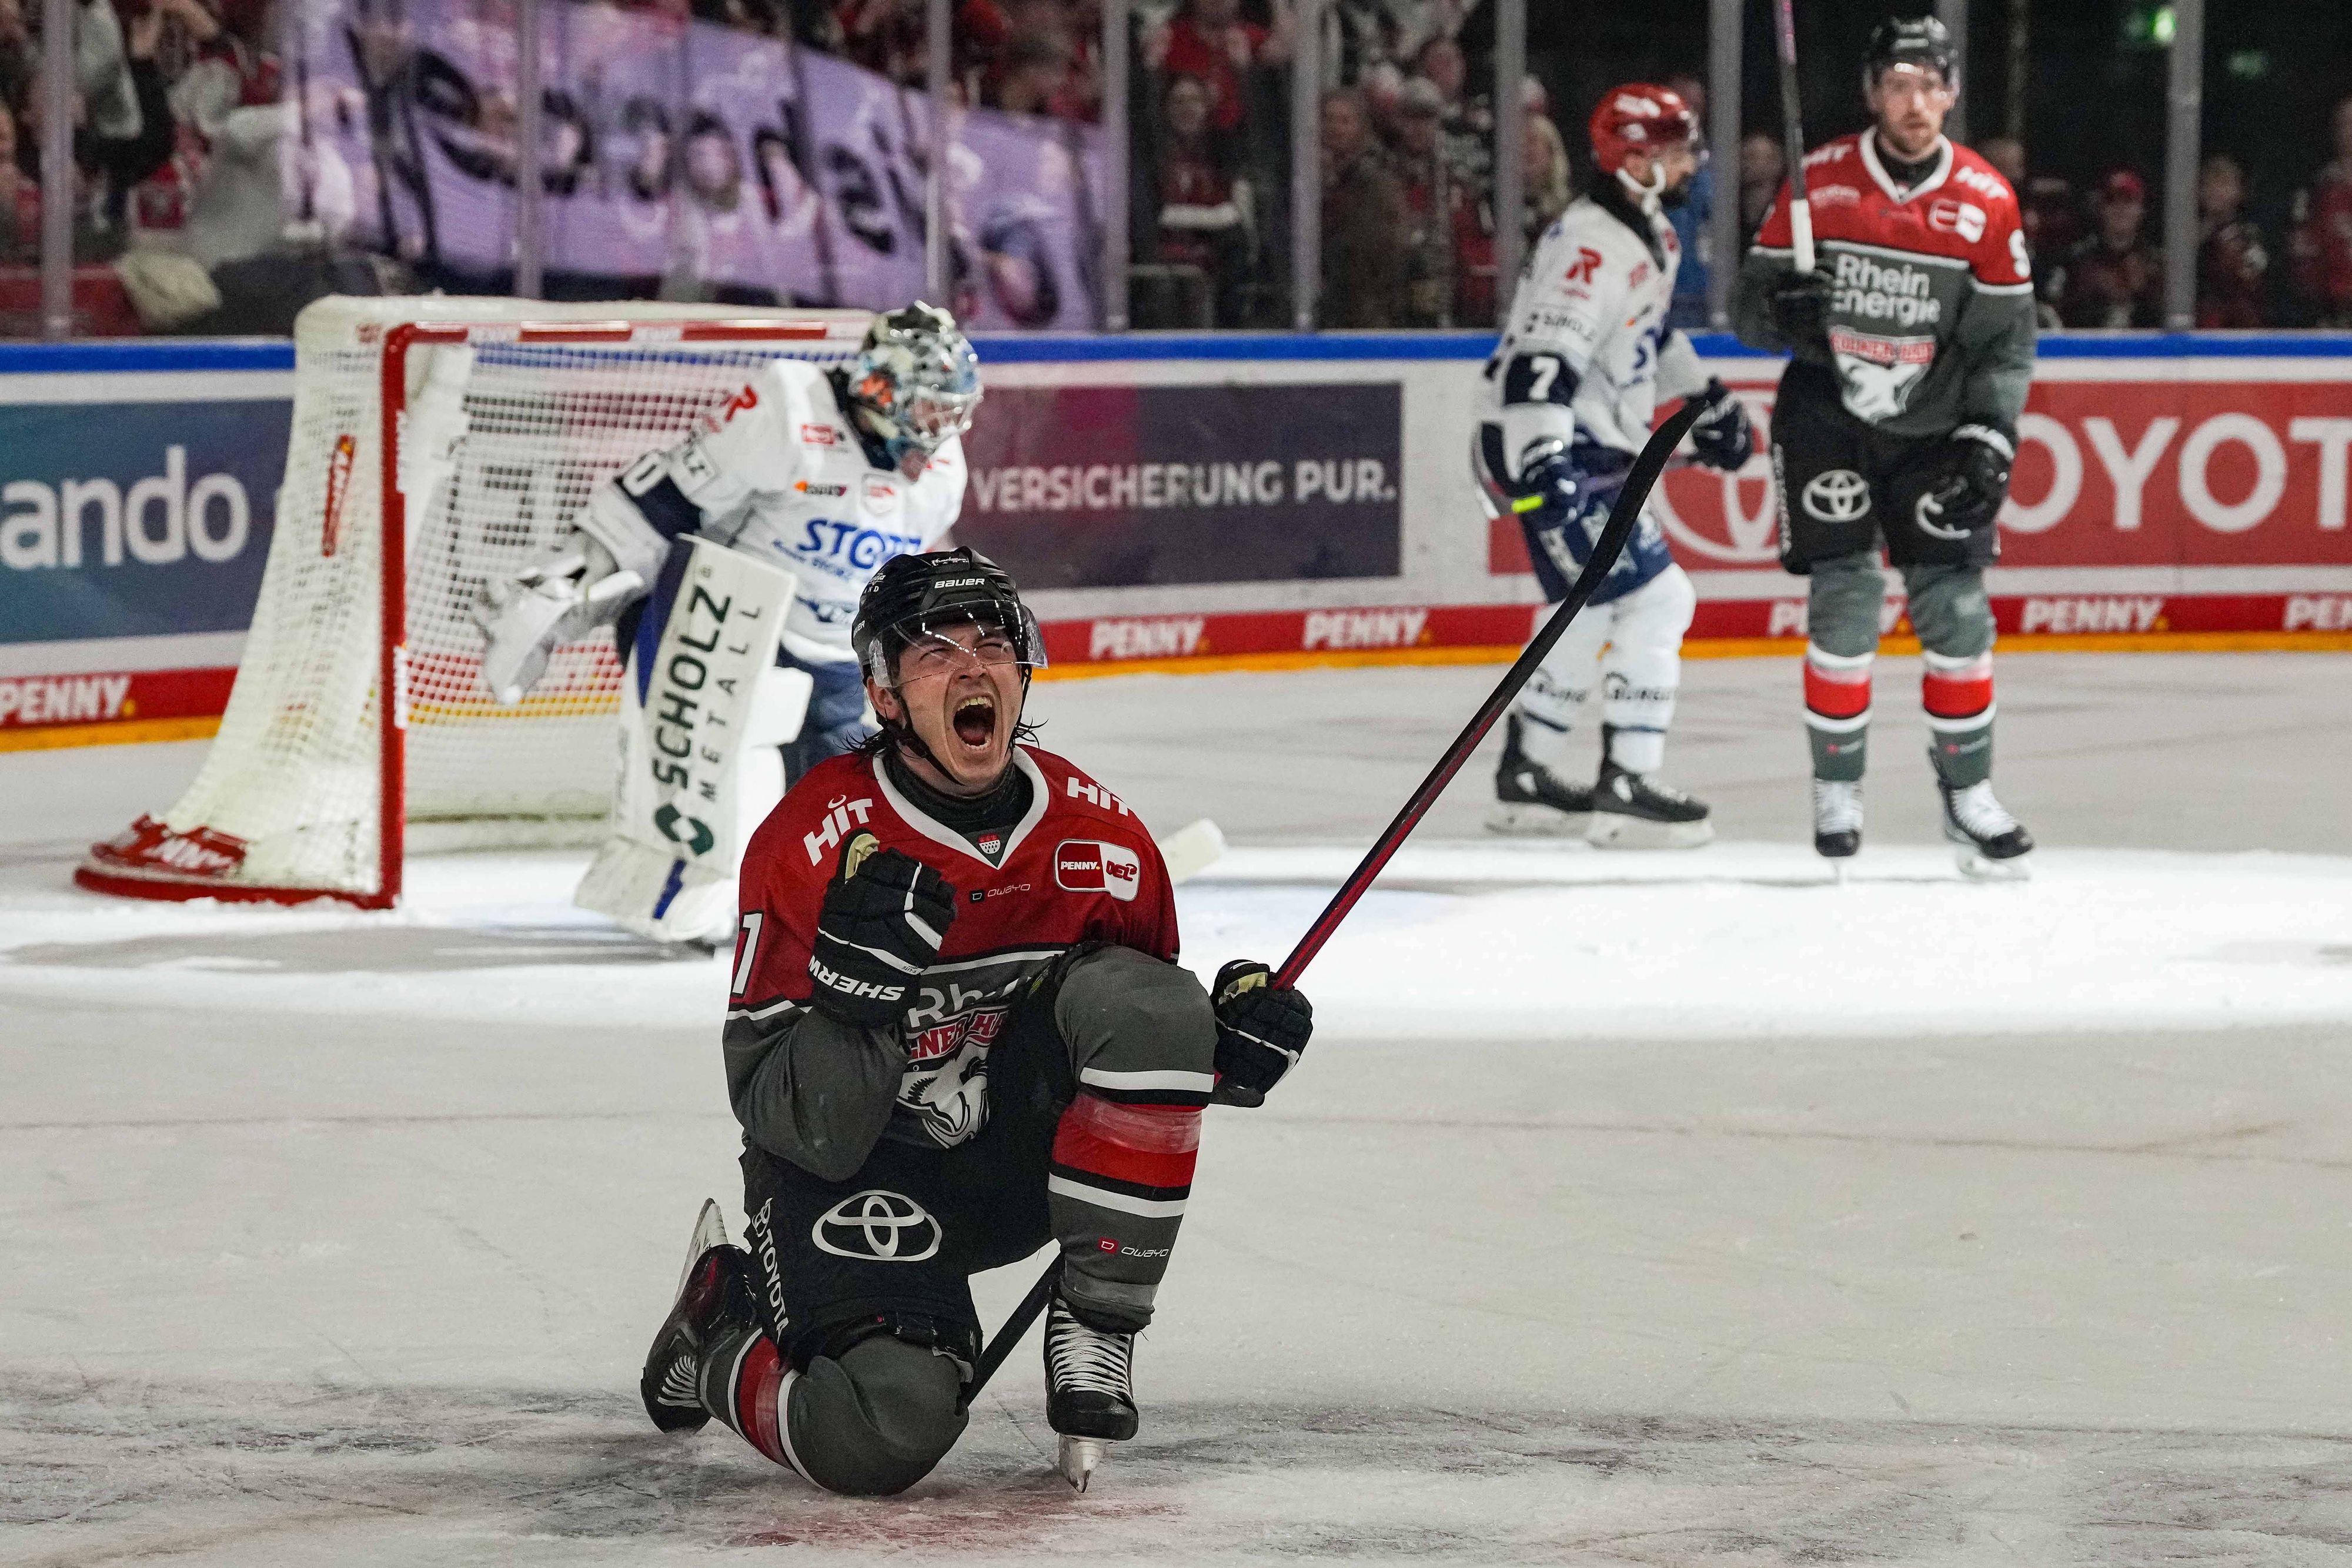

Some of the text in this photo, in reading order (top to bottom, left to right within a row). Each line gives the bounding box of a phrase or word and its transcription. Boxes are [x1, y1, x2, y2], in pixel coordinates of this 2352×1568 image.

[1835, 253, 1931, 297] Rhein
[1529, 355, 1559, 401] 7
[0, 444, 250, 569] ando
[970, 457, 1397, 511] VERSICHERUNG PUR.
[934, 578, 985, 589] BAUER
[652, 584, 731, 790] SCHOLZ
[699, 606, 762, 802] METALL
[1067, 777, 1128, 817] HIT
[803, 795, 873, 867] HIT
[759, 1228, 789, 1344] TOYOTA
